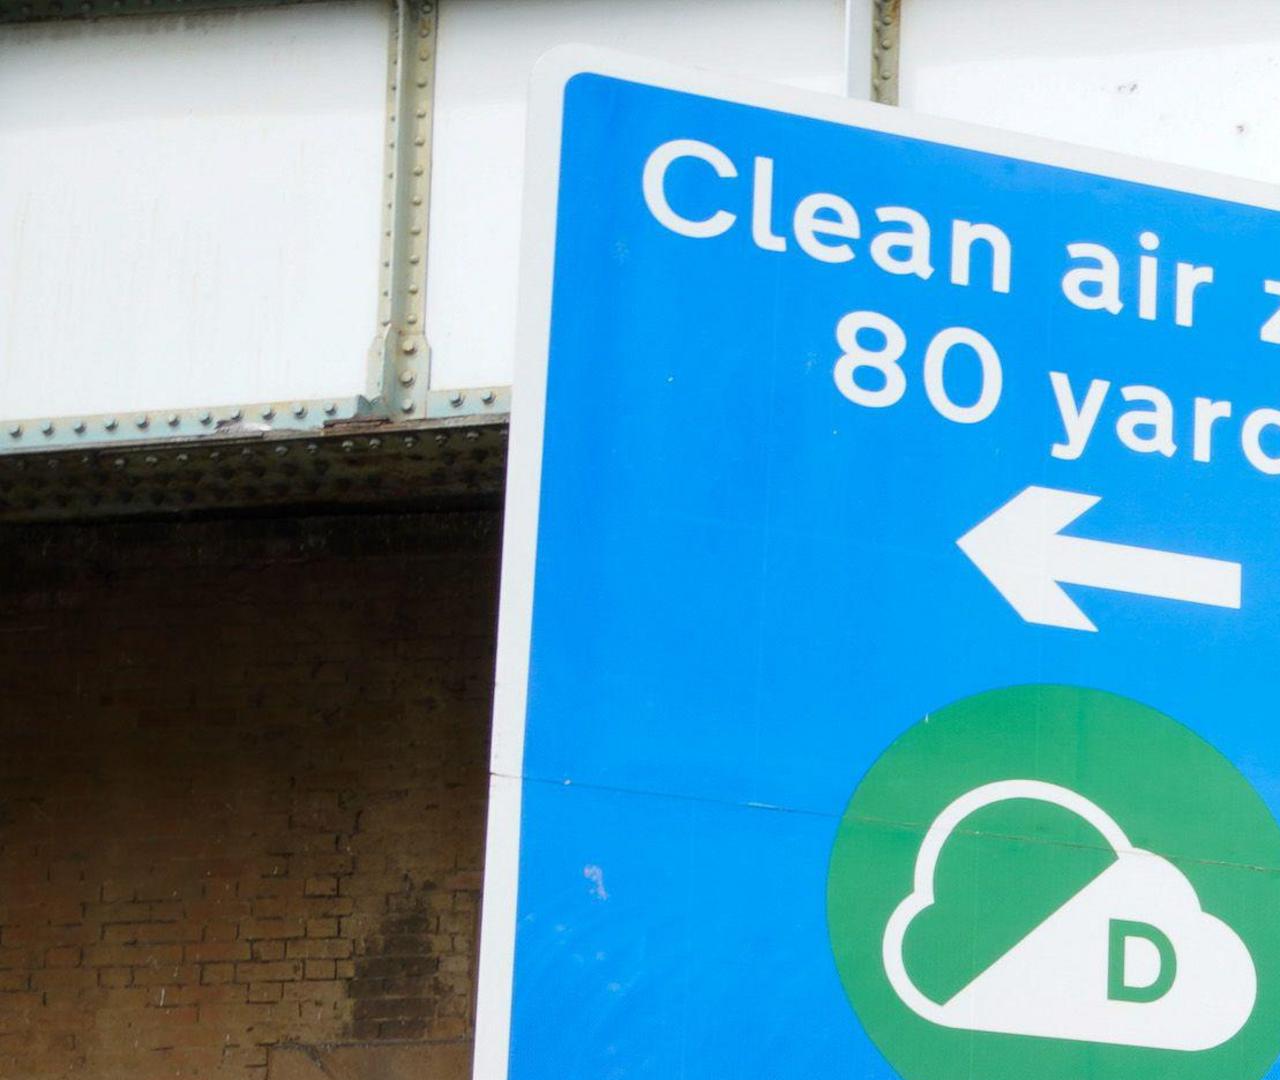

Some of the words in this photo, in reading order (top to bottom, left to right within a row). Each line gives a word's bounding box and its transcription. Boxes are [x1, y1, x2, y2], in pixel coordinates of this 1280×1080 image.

[642, 139, 1011, 293] Clean
[1061, 231, 1213, 327] air
[833, 311, 1003, 424] 80
[1107, 918, 1178, 1004] D
